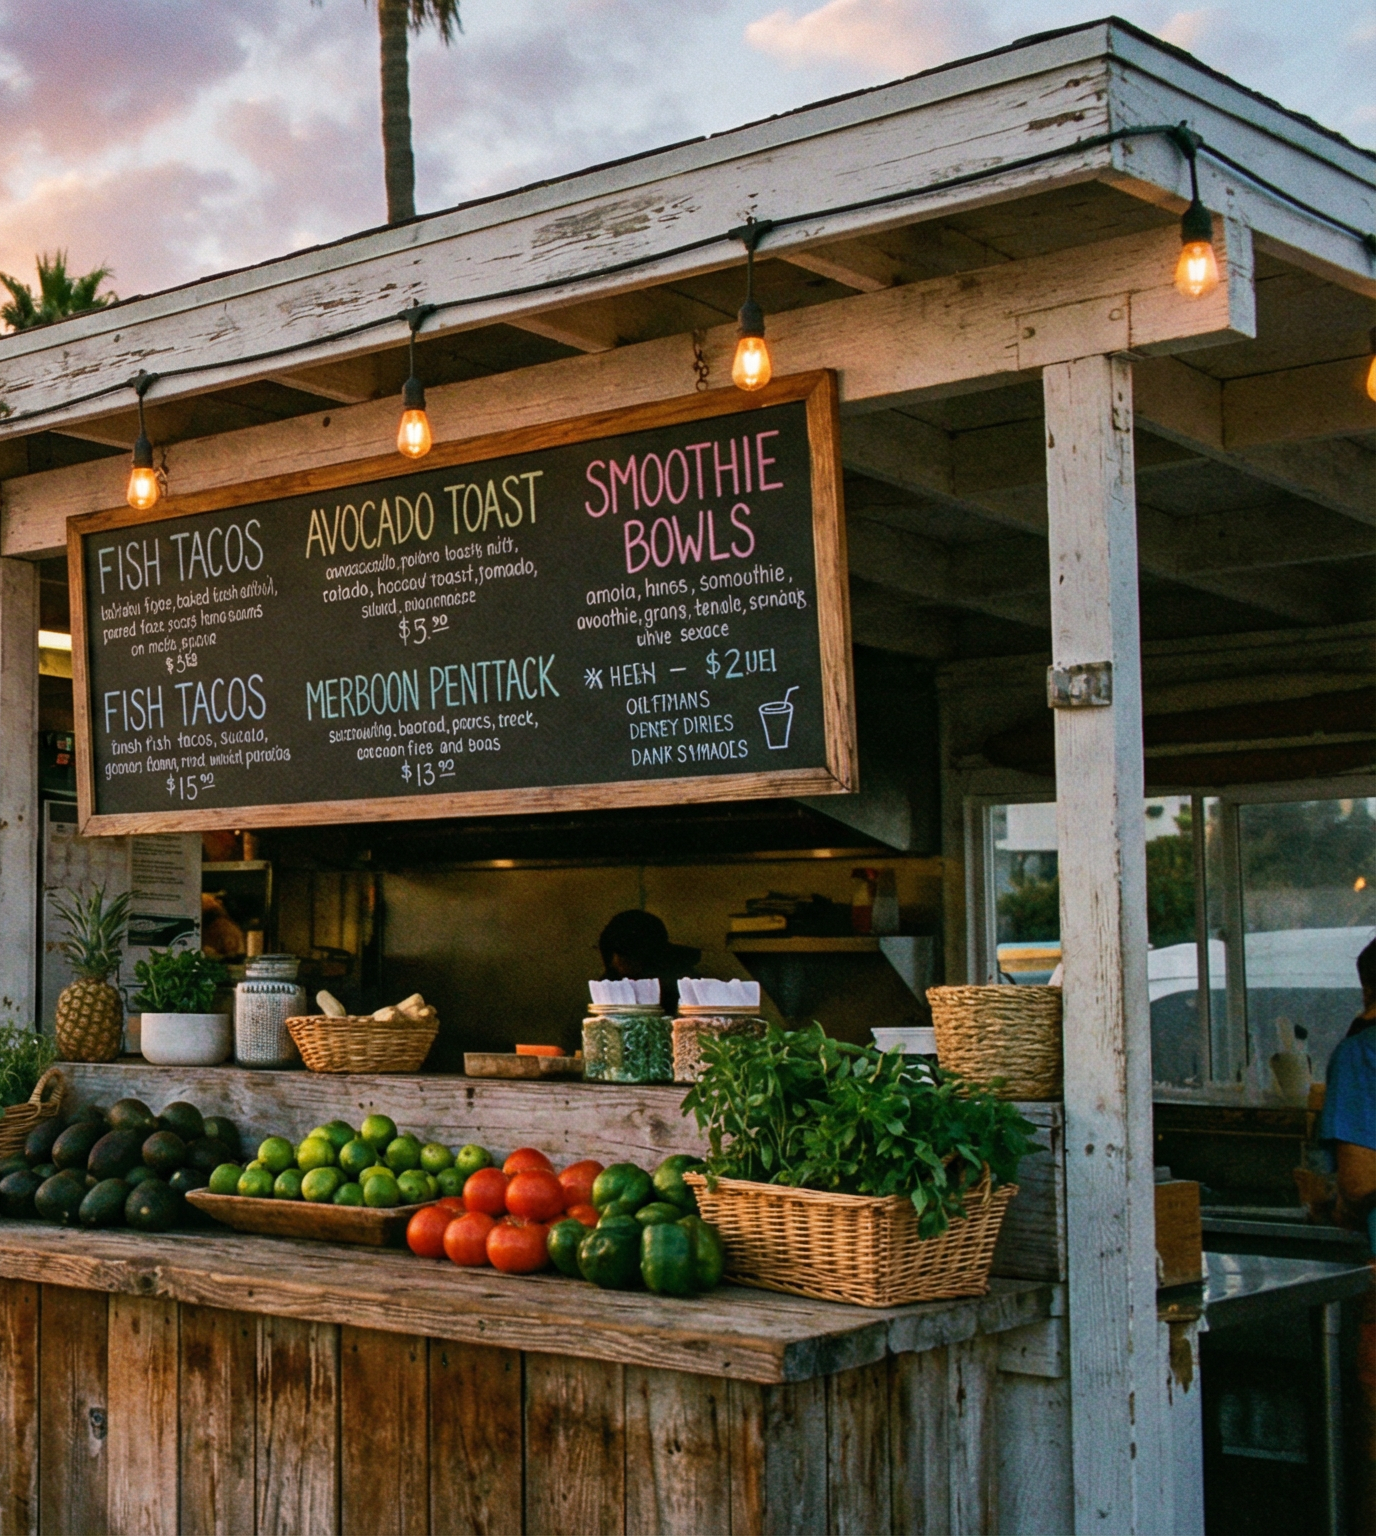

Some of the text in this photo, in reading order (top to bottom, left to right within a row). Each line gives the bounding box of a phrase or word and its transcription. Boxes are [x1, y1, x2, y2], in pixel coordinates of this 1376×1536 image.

[585, 429, 784, 518] SMOOTHIE
[306, 470, 544, 559] AVOCADO TOAST
[624, 502, 755, 574] BOWLS
[98, 538, 160, 594] FISH
[170, 519, 264, 581] TACOS
[131, 644, 145, 657] on
[104, 674, 267, 733] FISH TACOS
[306, 653, 560, 722] MERBOON PENTTACK
[439, 737, 463, 754] and
